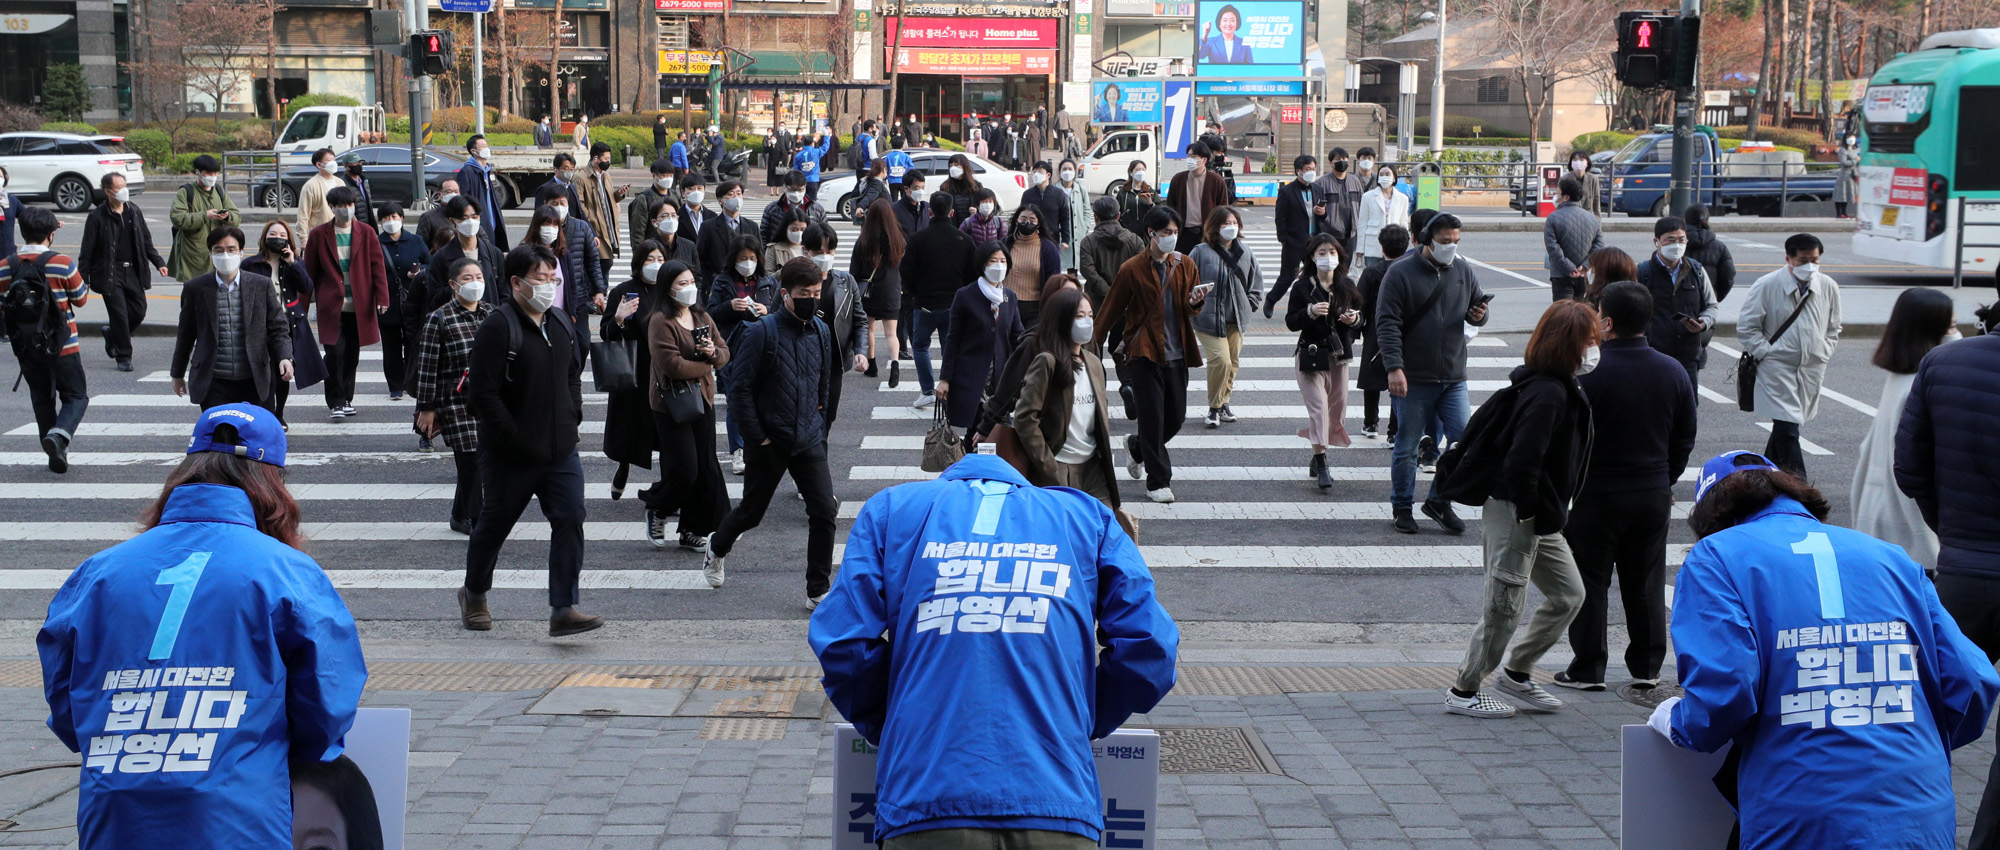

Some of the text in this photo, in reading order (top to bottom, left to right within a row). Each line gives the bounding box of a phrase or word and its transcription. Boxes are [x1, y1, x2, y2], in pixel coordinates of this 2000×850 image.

[5, 19, 29, 30] 103
[902, 29, 924, 38] 생활에
[958, 29, 979, 39] 됩니다
[984, 29, 1038, 38] Home plus
[1249, 23, 1294, 36] 합니다
[1241, 36, 1286, 48] 박영선
[918, 52, 949, 65] 한달간
[950, 52, 981, 65] 초저가
[981, 53, 1022, 65] 프로젝트
[1908, 85, 1929, 114] 88
[1165, 87, 1191, 153] 1
[921, 541, 1059, 560] 서울시 대전환
[934, 559, 1072, 598] 합니다
[1790, 532, 1846, 619] 1
[148, 551, 213, 660] 1
[916, 595, 1050, 635] 박영선
[1776, 621, 1908, 650] 서울시 대전환
[101, 666, 236, 691] 서울시 대전환
[1796, 643, 1920, 689] 합니다
[103, 690, 249, 732] 합니다
[1780, 684, 1915, 730] 박영선
[85, 732, 220, 774] 박영선
[1107, 745, 1146, 760] 박영선
